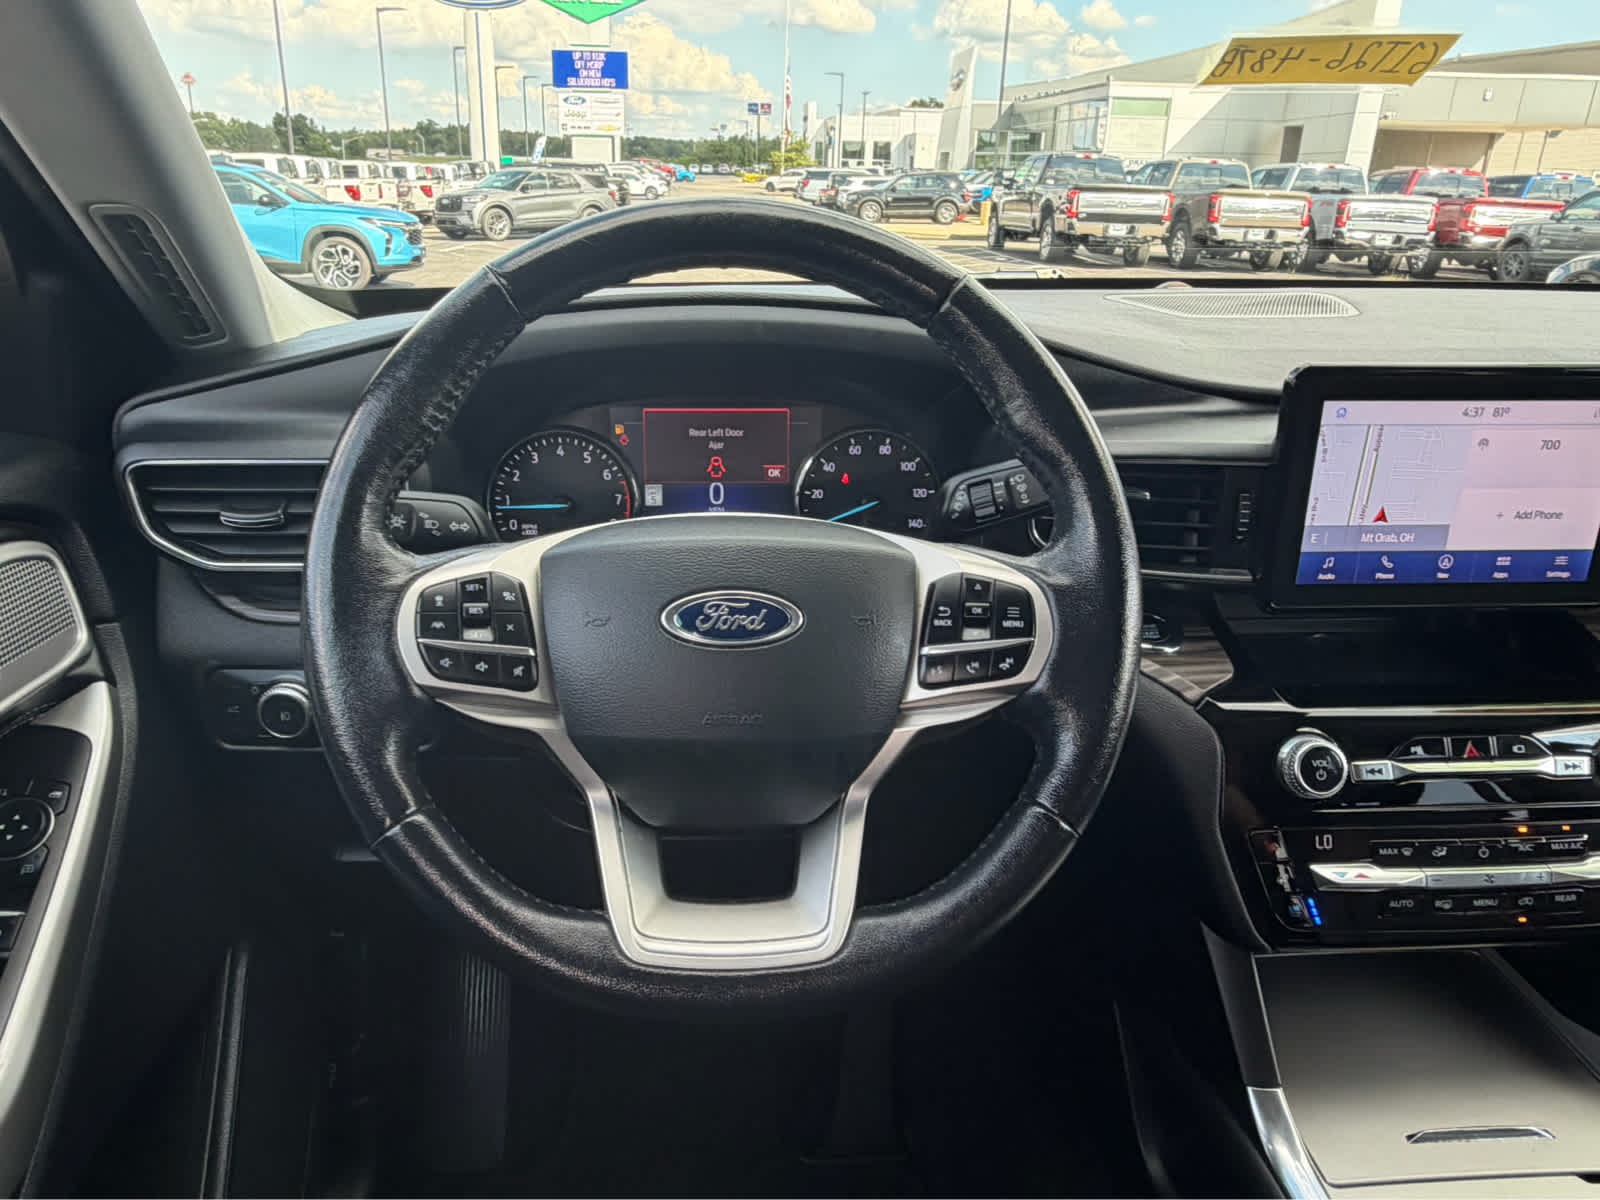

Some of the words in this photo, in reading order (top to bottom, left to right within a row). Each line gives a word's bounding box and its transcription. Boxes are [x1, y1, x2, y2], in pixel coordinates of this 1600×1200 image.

[1462, 407, 1485, 418] 4:37
[688, 428, 706, 437] Rear
[708, 428, 723, 437] Left
[725, 428, 744, 437] Door
[708, 441, 724, 449] Ajar
[1540, 439, 1561, 450] 700
[556, 445, 565, 457] 4
[848, 445, 861, 455] 60
[878, 445, 891, 455] 80
[531, 452, 539, 464] 3
[583, 452, 592, 464] 5
[823, 462, 835, 472] 40
[900, 461, 916, 472] 100
[512, 470, 520, 482] 2
[603, 468, 611, 480] 6
[768, 469, 781, 478] OK
[709, 482, 724, 505] 0
[811, 489, 824, 499] 20
[913, 488, 927, 498] 120
[505, 495, 511, 506] 1
[615, 494, 622, 505] 7
[1514, 511, 1532, 520] Add
[1534, 511, 1563, 520] Phone
[509, 519, 518, 530] 0
[908, 519, 923, 528] 140
[1361, 533, 1374, 543] Mt
[1399, 532, 1415, 543] OH
[696, 600, 768, 632] Ford
[933, 619, 953, 627] BACK
[1002, 620, 1025, 628] MENU
[1311, 759, 1328, 768] VOL
[1315, 834, 1333, 849] LO
[1379, 848, 1398, 856] MAX
[1389, 899, 1414, 908] AUTO
[1473, 899, 1498, 907] MENU
